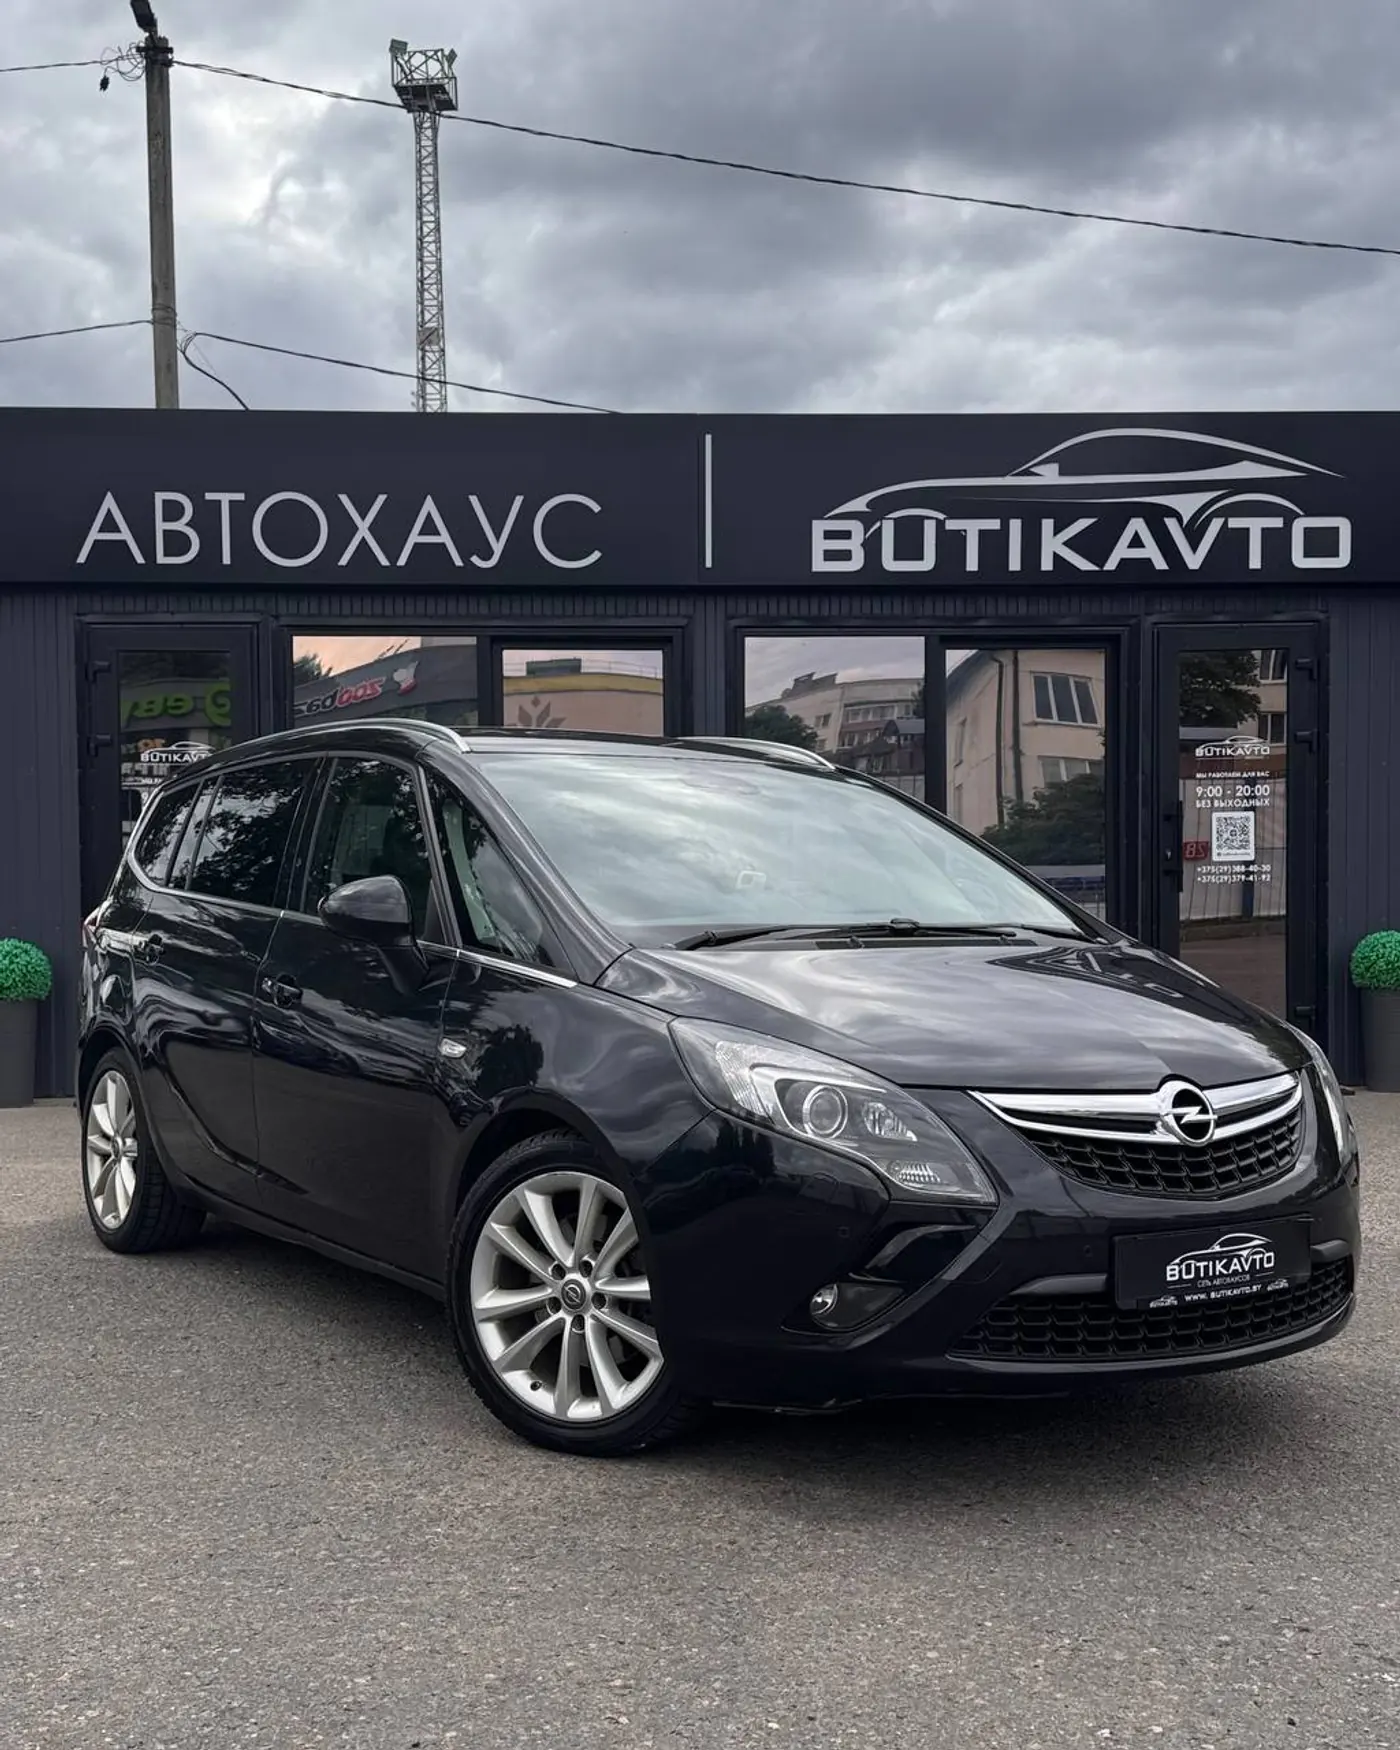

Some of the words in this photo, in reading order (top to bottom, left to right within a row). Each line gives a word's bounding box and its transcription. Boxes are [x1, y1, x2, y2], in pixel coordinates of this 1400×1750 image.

[76, 489, 604, 569] АВТОХАУС
[810, 516, 1353, 573] BUTIKAVTO
[141, 752, 206, 762] BUTIKAVT
[1195, 746, 1270, 757] BUTIKAVTO
[1196, 785, 1223, 797] 9:00
[1235, 784, 1270, 796] 20:00
[1196, 799, 1211, 808] БЕЗ
[1213, 798, 1270, 808] ВЫХОДНЫХ
[1166, 1252, 1275, 1281] BUTIKAVTO
